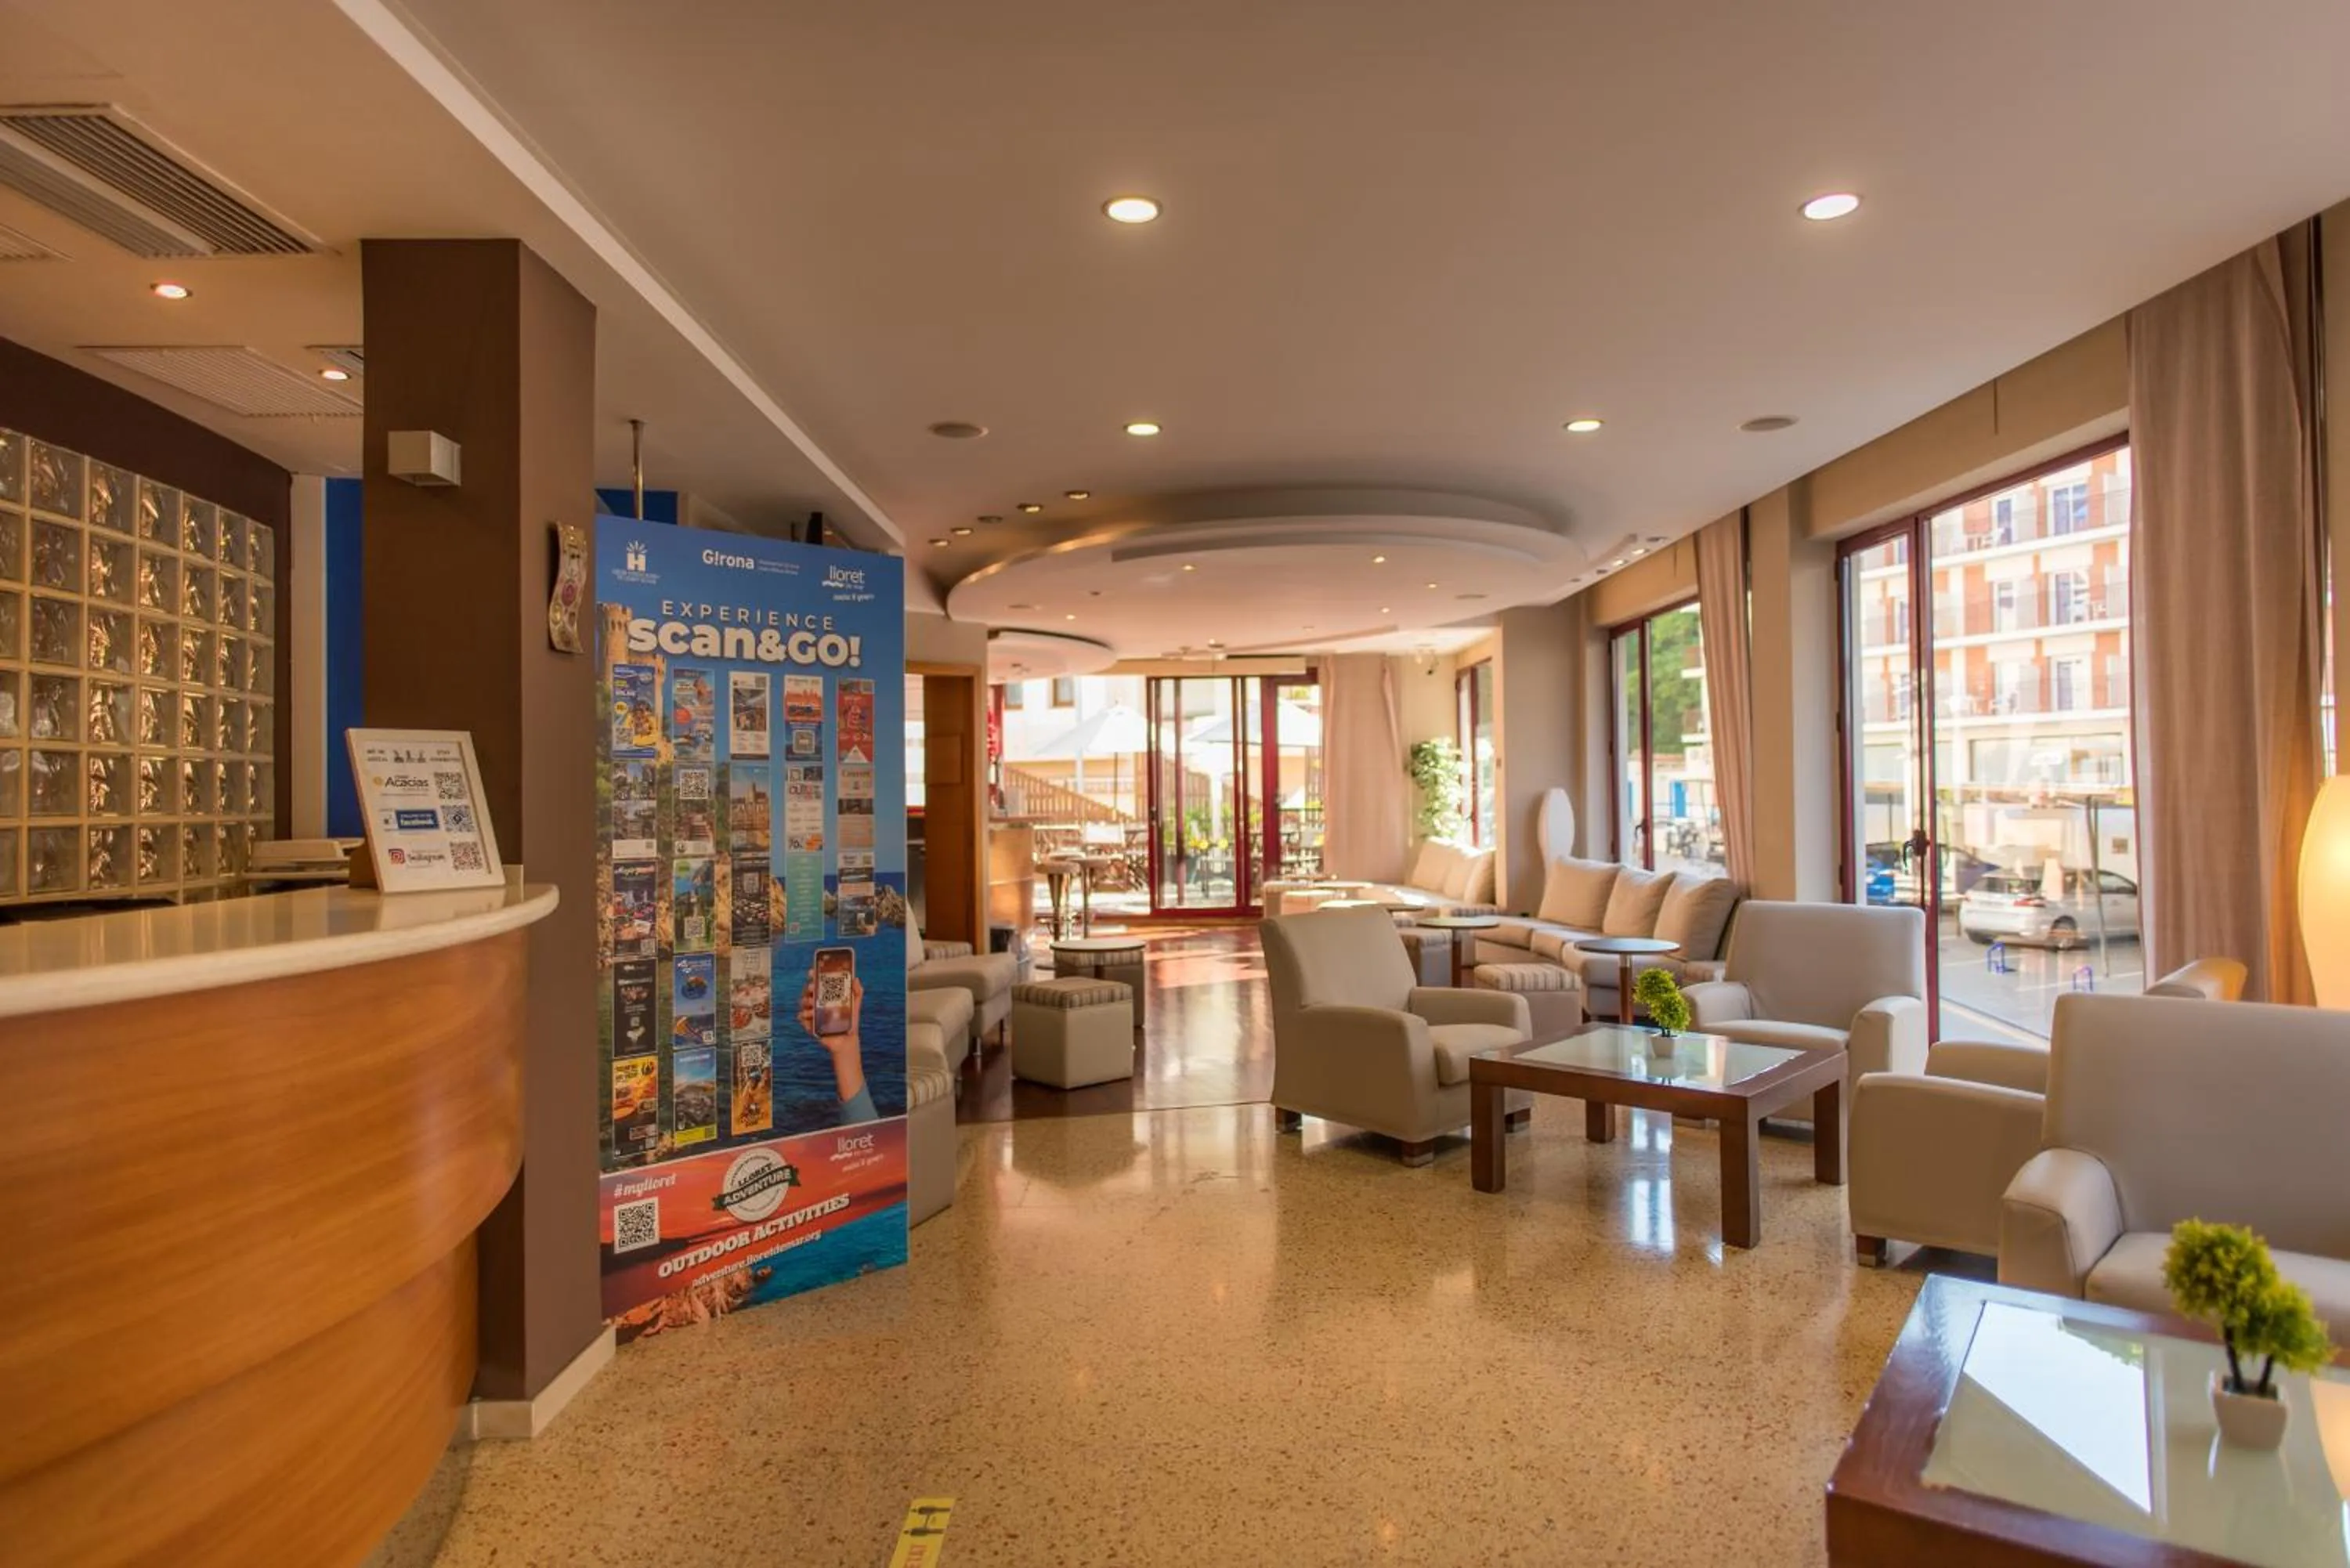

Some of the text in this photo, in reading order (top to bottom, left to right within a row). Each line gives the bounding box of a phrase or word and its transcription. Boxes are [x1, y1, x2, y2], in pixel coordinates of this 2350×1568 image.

[829, 565, 866, 584] lloret
[662, 600, 833, 631] EXPERIENCE
[385, 776, 429, 788] Acacias
[837, 1133, 875, 1153] lloret
[614, 1172, 677, 1199] #mylloret
[723, 1168, 791, 1205] ADVENTURE
[738, 1162, 773, 1187] LLORET
[657, 1194, 851, 1278] OUTDOOR ACTIVITIES
